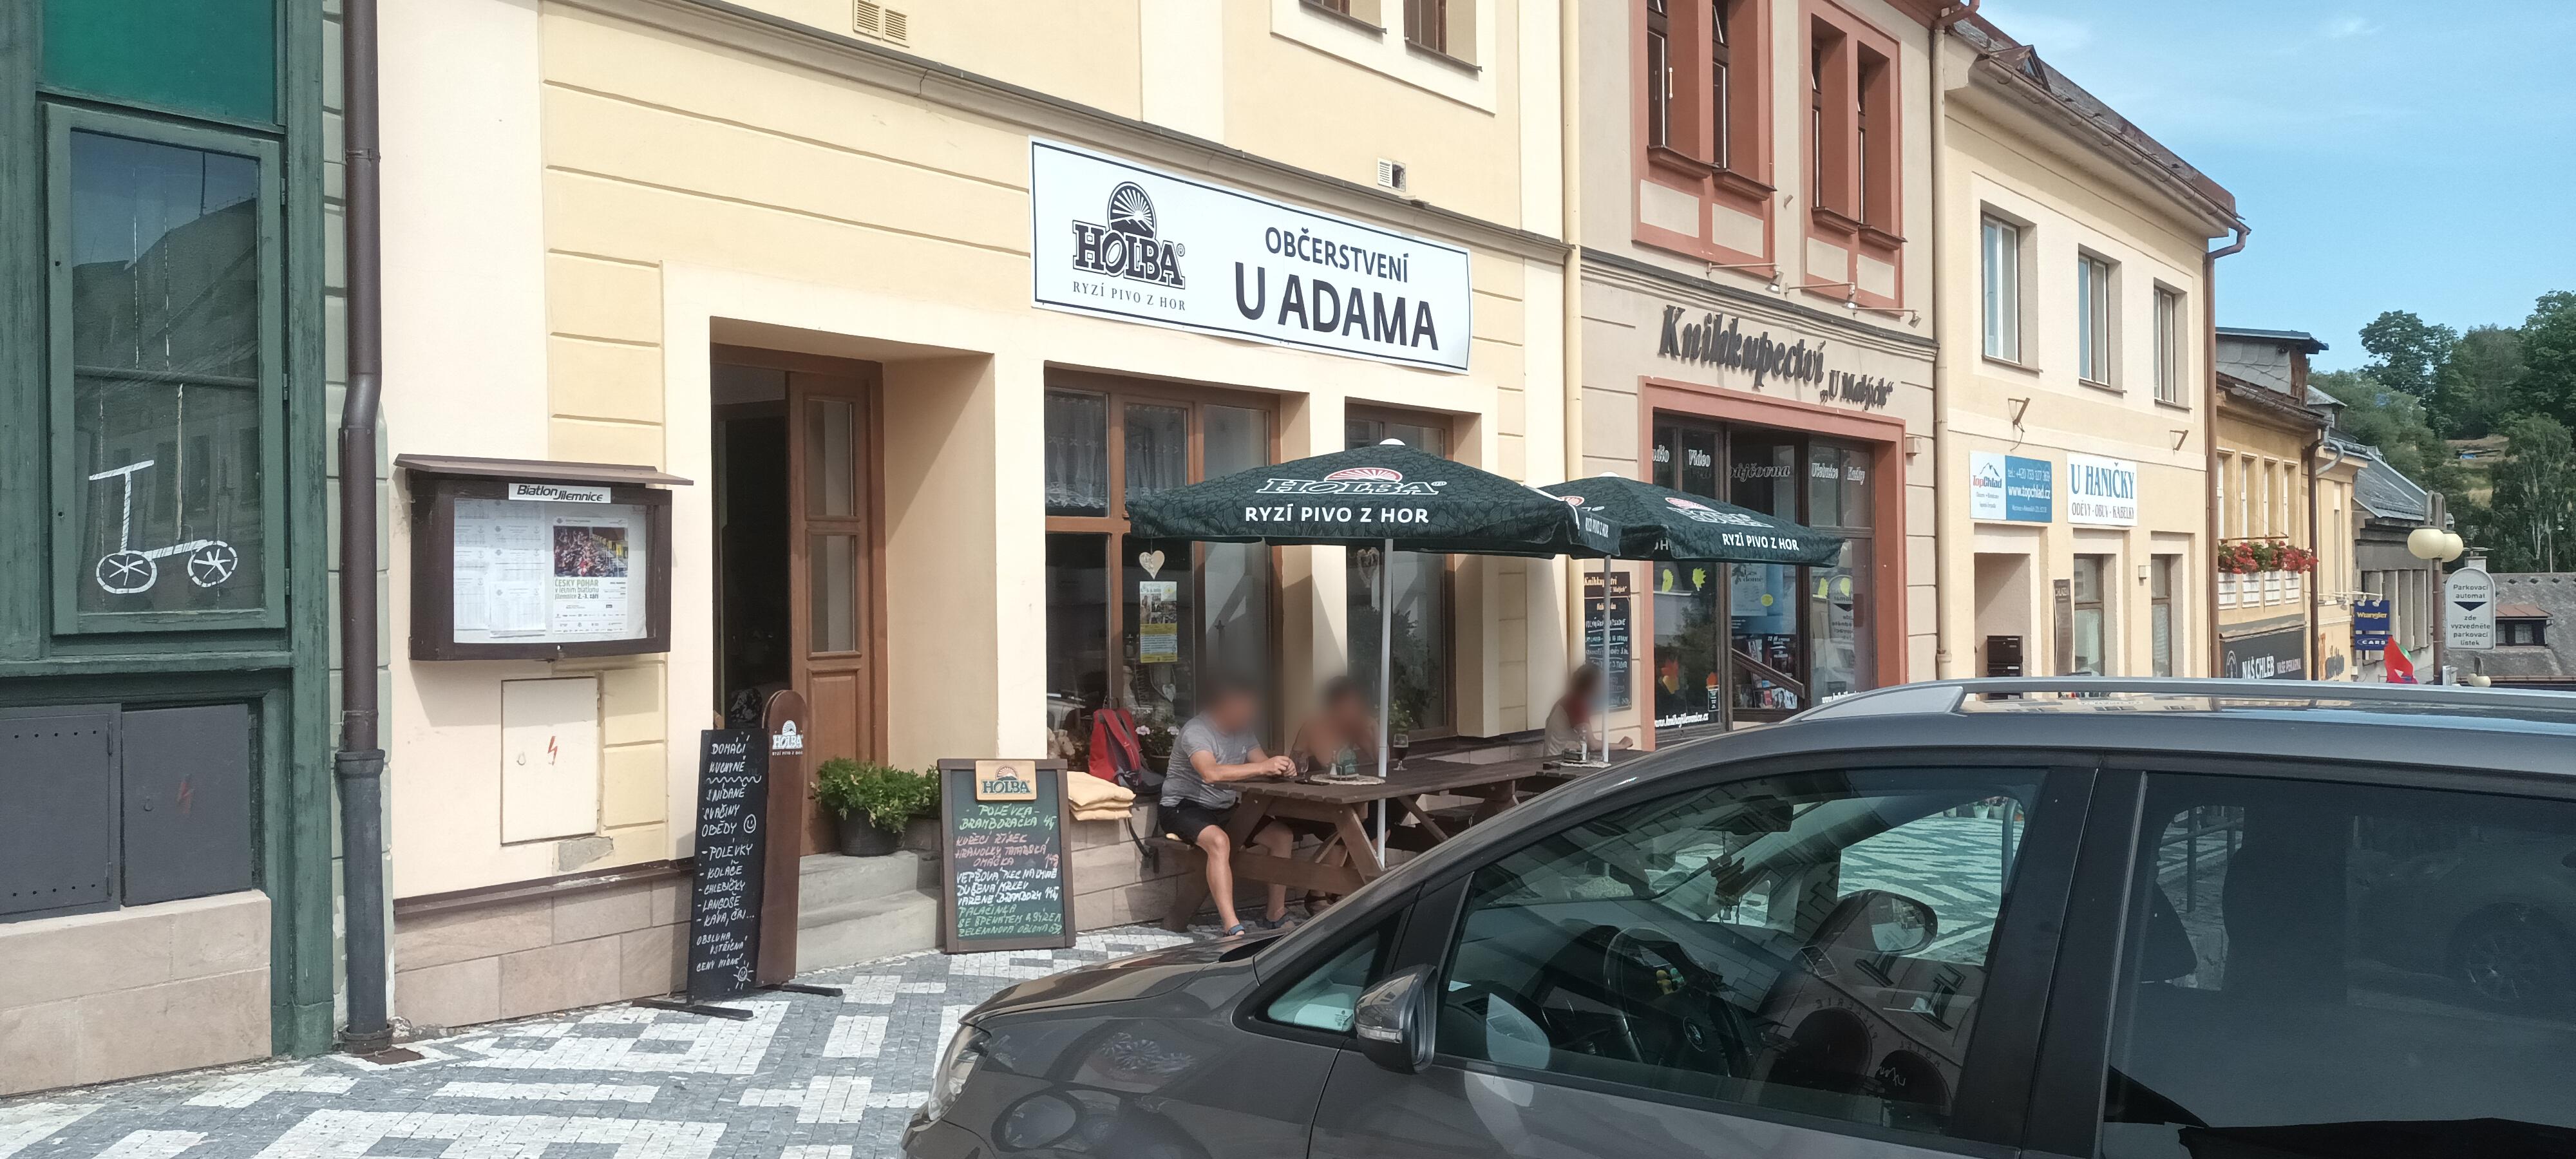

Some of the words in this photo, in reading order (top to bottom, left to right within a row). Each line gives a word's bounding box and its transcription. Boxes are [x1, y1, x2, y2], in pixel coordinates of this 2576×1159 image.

[1265, 227, 1409, 283] OBČERSTVENÍ
[1073, 281, 1105, 297] RYZÍ
[1112, 288, 1141, 304] PIVO
[1147, 294, 1154, 306] Z
[1159, 297, 1186, 311] HOR
[1235, 261, 1265, 320] U
[1278, 274, 1439, 350] ADAMA
[1657, 305, 1826, 388] Knihkupectví
[1689, 449, 1710, 467] Video
[1973, 475, 2002, 488] TopChlad
[2070, 464, 2080, 494] U
[2085, 462, 2134, 499] HANIČKY
[517, 485, 558, 496] Biatlon
[553, 491, 603, 501] Jilemnice
[2008, 484, 2050, 501] www.topchlad.cz
[1245, 504, 1293, 522] RYZÍ
[1302, 507, 1352, 522] PIVO
[1360, 508, 1372, 523] Z
[1381, 508, 1429, 523] HOR
[1722, 532, 1745, 547] RYZÍ
[1747, 535, 1767, 548] PIVO
[1770, 537, 1776, 549] Z
[1779, 538, 1799, 551] HOR
[555, 578, 575, 587] ČESKÝ
[2242, 656, 2255, 679] NÁŠ
[2255, 653, 2274, 679] CHLÉB
[712, 735, 750, 755] DOMÁCÍ
[706, 782, 747, 802] SNÍDANĚ
[703, 804, 740, 820] SVAČINY
[978, 804, 1032, 816] POLÉVKA
[702, 820, 737, 837] OBĚDY
[960, 815, 1037, 830] BRAMBORAČKA
[710, 838, 753, 861] POLÉVKY
[973, 854, 1014, 867] OMÁČKA
[707, 860, 743, 880] KOLÁČE
[1023, 869, 1034, 879] NA
[704, 878, 745, 895] CHLEBÍČKY
[998, 881, 1029, 892] MRKEV
[703, 891, 741, 912] LANGOŠE
[996, 890, 1042, 903] BRAMBORY
[704, 910, 728, 927] KÁVA,
[958, 904, 1017, 918] PALAČINKA
[958, 918, 971, 928] SE
[1026, 913, 1031, 922] A
[697, 932, 730, 946] OBSLUHA
[697, 960, 715, 972] CENY
